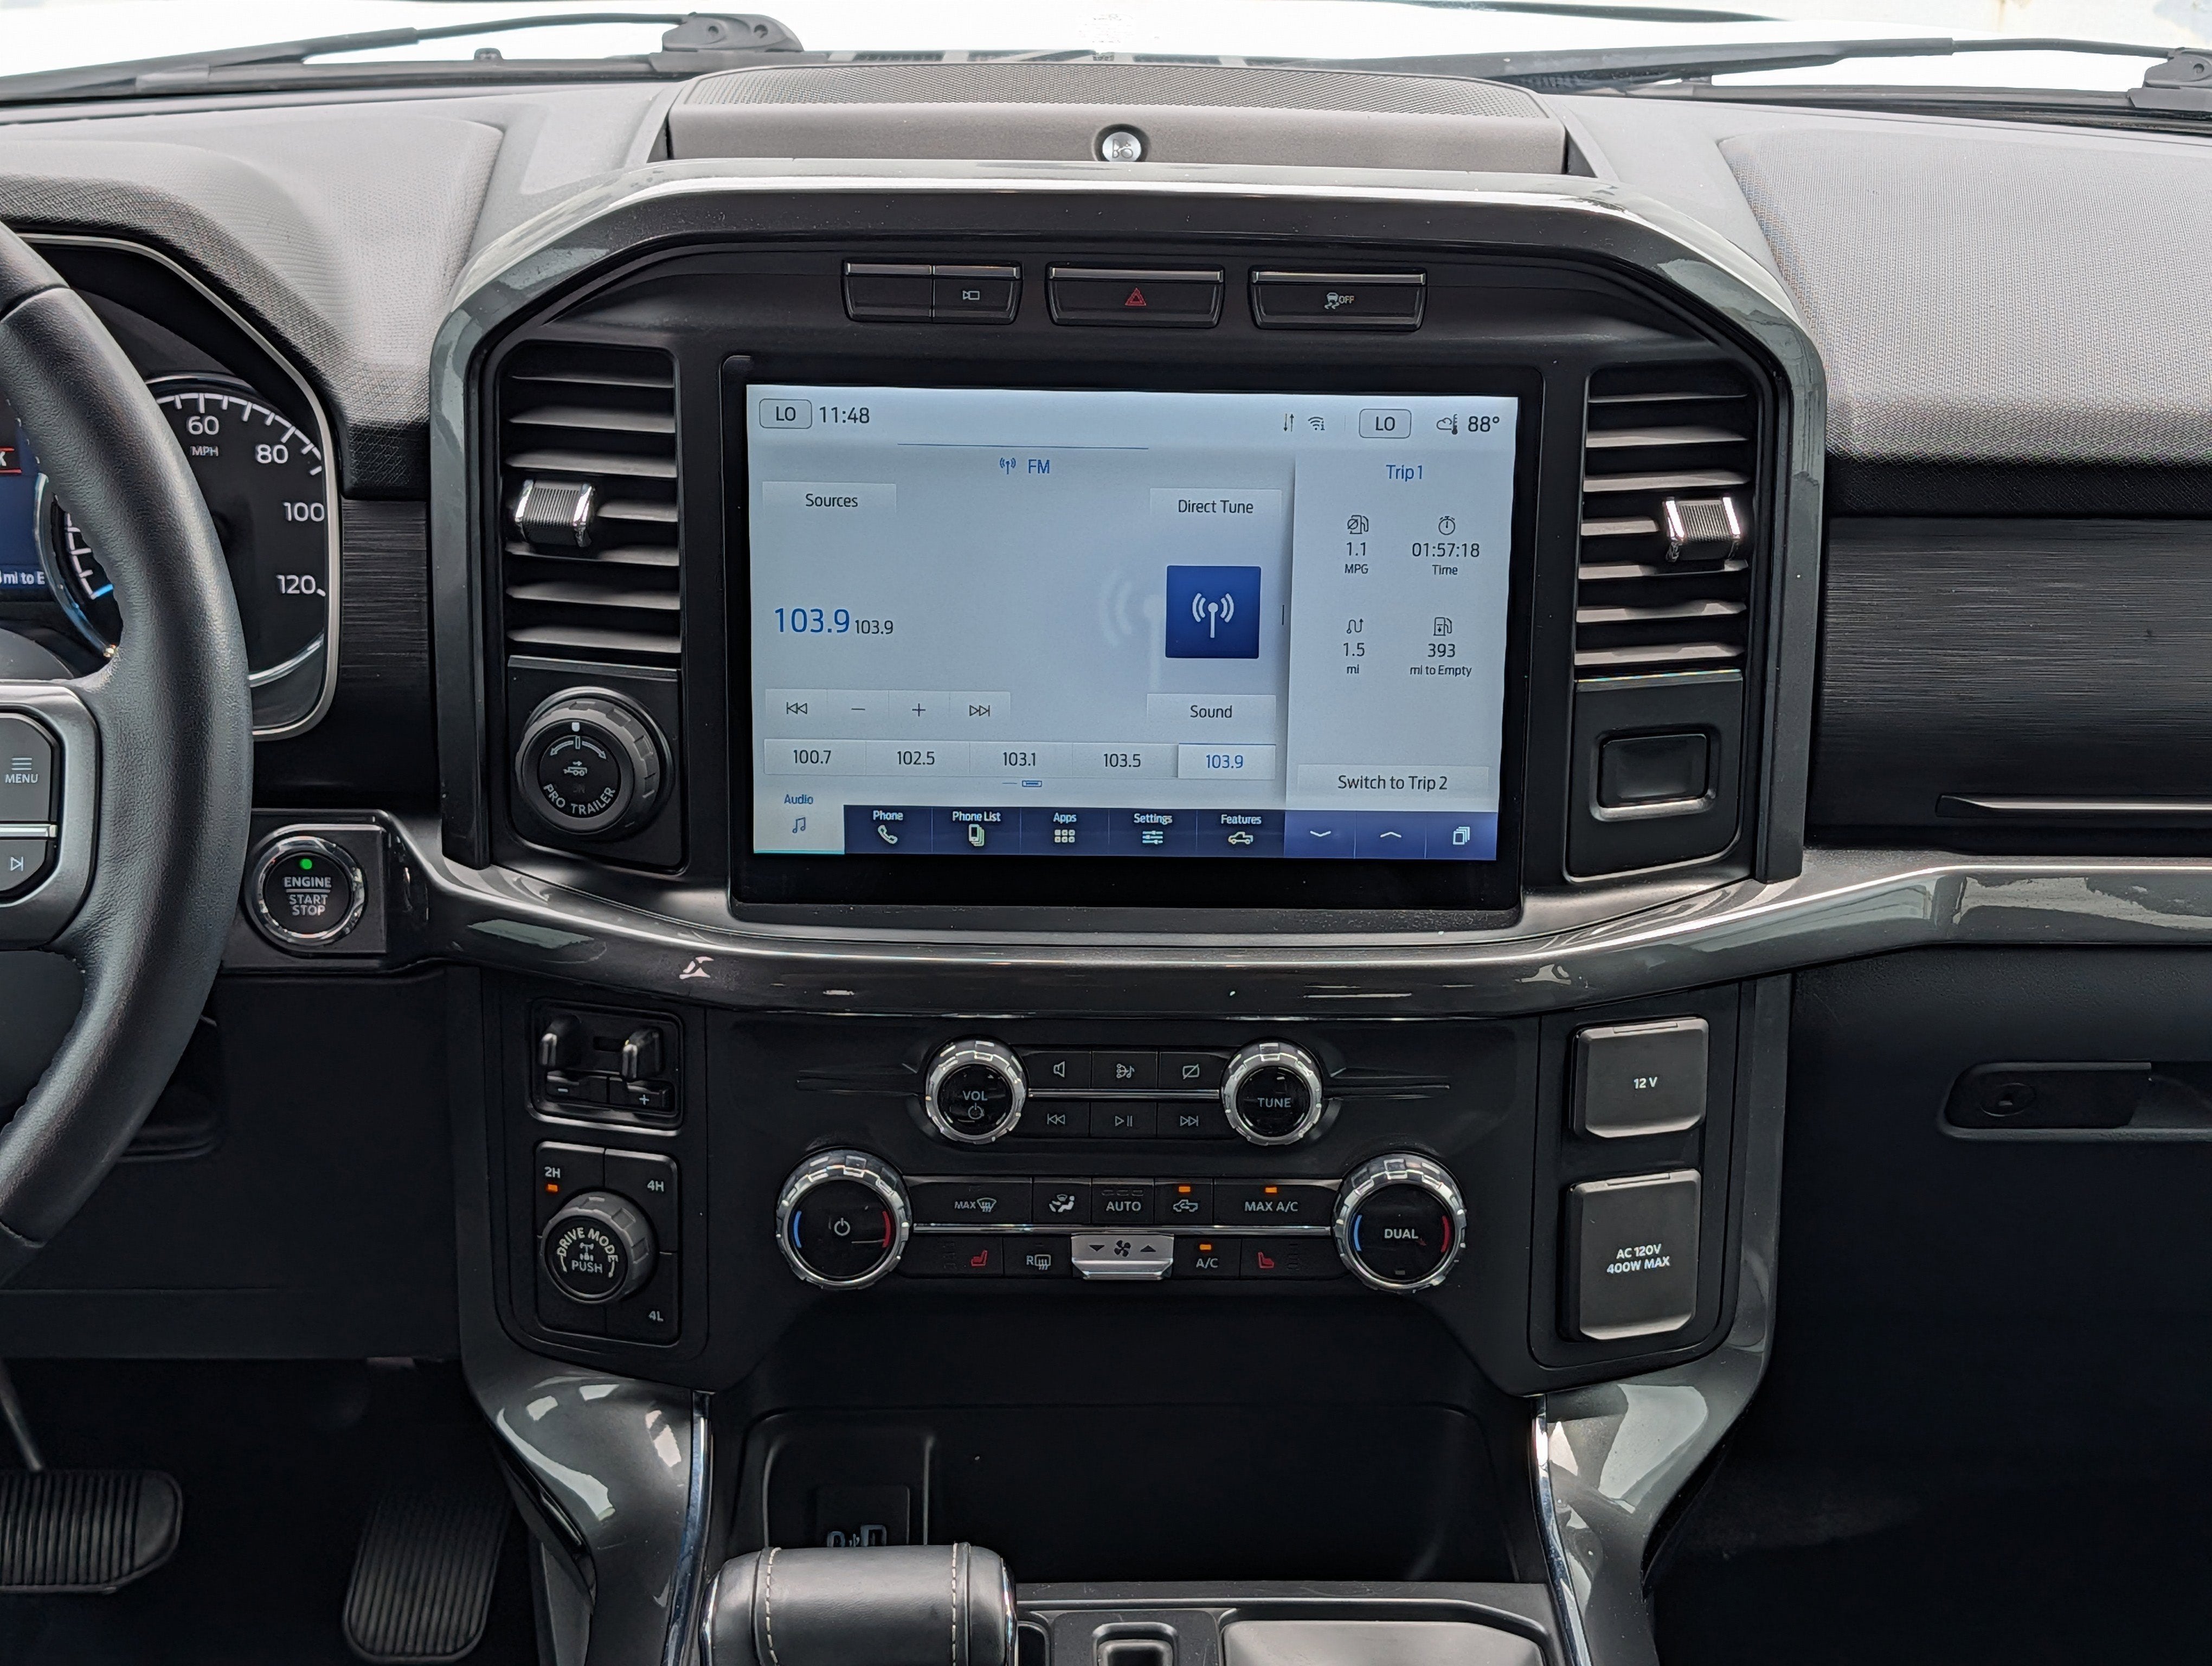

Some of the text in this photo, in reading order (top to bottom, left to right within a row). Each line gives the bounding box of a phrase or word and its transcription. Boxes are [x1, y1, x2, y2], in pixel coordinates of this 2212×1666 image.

[1339, 296, 1355, 304] OFF
[776, 407, 796, 422] LO
[819, 407, 870, 424] 11:48
[187, 416, 220, 435] 60
[1375, 416, 1396, 431] LO
[191, 446, 218, 456] MPH
[255, 444, 288, 464] 80
[1028, 459, 1050, 474] FM
[1386, 464, 1415, 482] Trip
[805, 493, 858, 508] Sources
[1178, 499, 1254, 514] Direct Tune
[284, 502, 325, 522] 100
[1346, 542, 1367, 556] 1.1
[1412, 542, 1480, 558] 01:57:18
[1345, 563, 1369, 574] MPG
[1432, 564, 1458, 575] Time
[21, 571, 35, 585] to
[276, 575, 316, 594] 120
[775, 607, 894, 635] 103.9 103.9
[1343, 642, 1366, 657] 1.5
[1427, 643, 1456, 658] 393
[1426, 665, 1436, 675] to
[1438, 665, 1472, 677] Empty
[1190, 705, 1233, 719] Sound
[793, 749, 832, 765] 100.7
[897, 751, 935, 766] 102.5
[1002, 752, 1037, 767] 103.1
[1103, 753, 1141, 768] 103.5
[1206, 754, 1244, 770] 103.9
[5, 773, 38, 784] MENU
[1338, 775, 1448, 792] Switch to Trip 2
[543, 783, 616, 815] PRO TRAILER
[784, 793, 814, 805] Audio
[872, 810, 904, 822] Phone
[952, 811, 1001, 823] Phone List
[1053, 812, 1077, 824] Apps
[1133, 813, 1173, 825] Settings
[1220, 814, 1262, 825] Features
[284, 876, 332, 889] ENGINE
[288, 894, 328, 906] START
[292, 905, 326, 917] STOP
[1634, 1076, 1658, 1090] 12 V
[962, 1090, 988, 1101] VOL
[1257, 1097, 1291, 1108] TUNE
[544, 1167, 561, 1178] 2H
[647, 1180, 665, 1193] 4H
[954, 1201, 976, 1209] MAX
[1105, 1201, 1142, 1212] AUTO
[1244, 1201, 1299, 1213] MAX A/C
[1384, 1228, 1419, 1240] DUAL
[556, 1226, 619, 1263] DRIVE MODE
[1616, 1243, 1662, 1260] AC 120V
[571, 1259, 603, 1274] PUSH
[1026, 1254, 1034, 1266] R
[1195, 1257, 1218, 1269] A/C
[1606, 1255, 1671, 1275] 400W MAX
[648, 1310, 664, 1322] 4L
